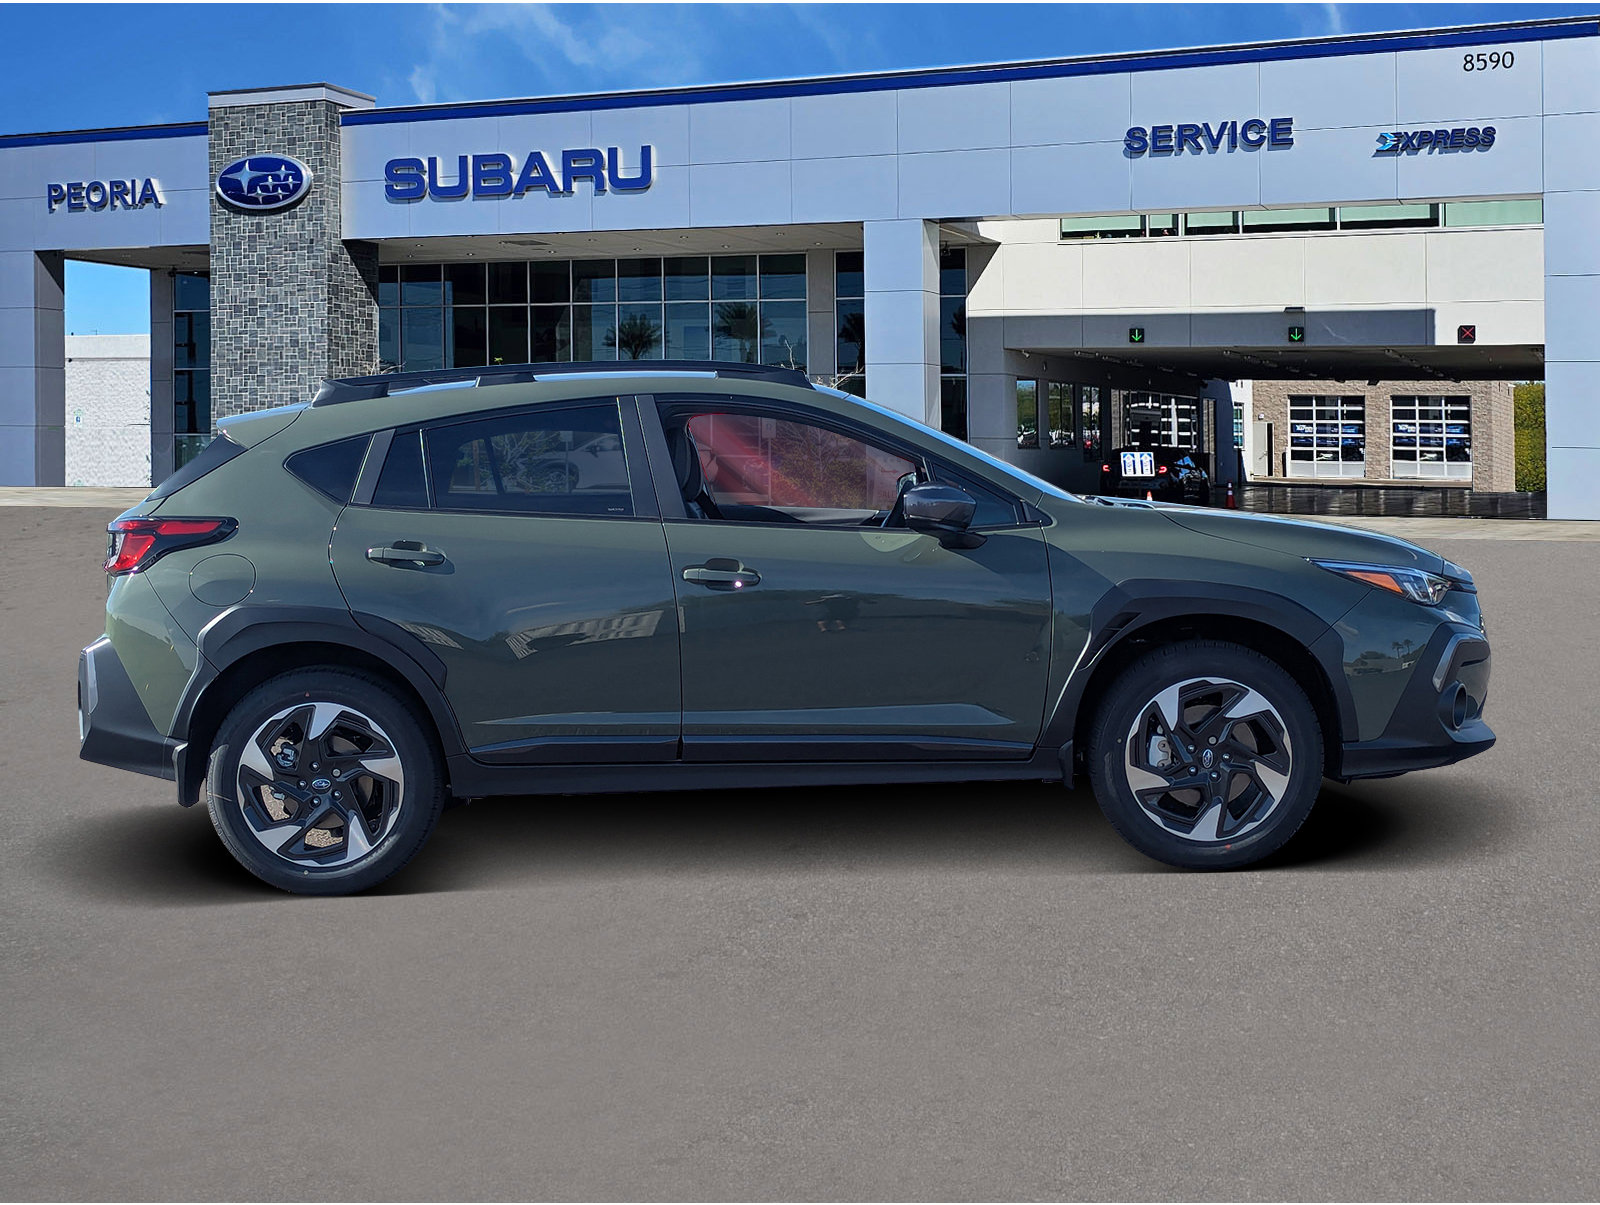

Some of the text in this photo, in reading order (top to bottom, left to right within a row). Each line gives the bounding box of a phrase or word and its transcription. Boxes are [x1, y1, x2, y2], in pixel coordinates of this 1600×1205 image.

[1463, 51, 1515, 72] 8590
[1124, 117, 1294, 153] SERVICE
[1375, 126, 1497, 153] EXPRESS
[384, 145, 653, 202] SUBARU
[47, 178, 164, 211] PEORIA
